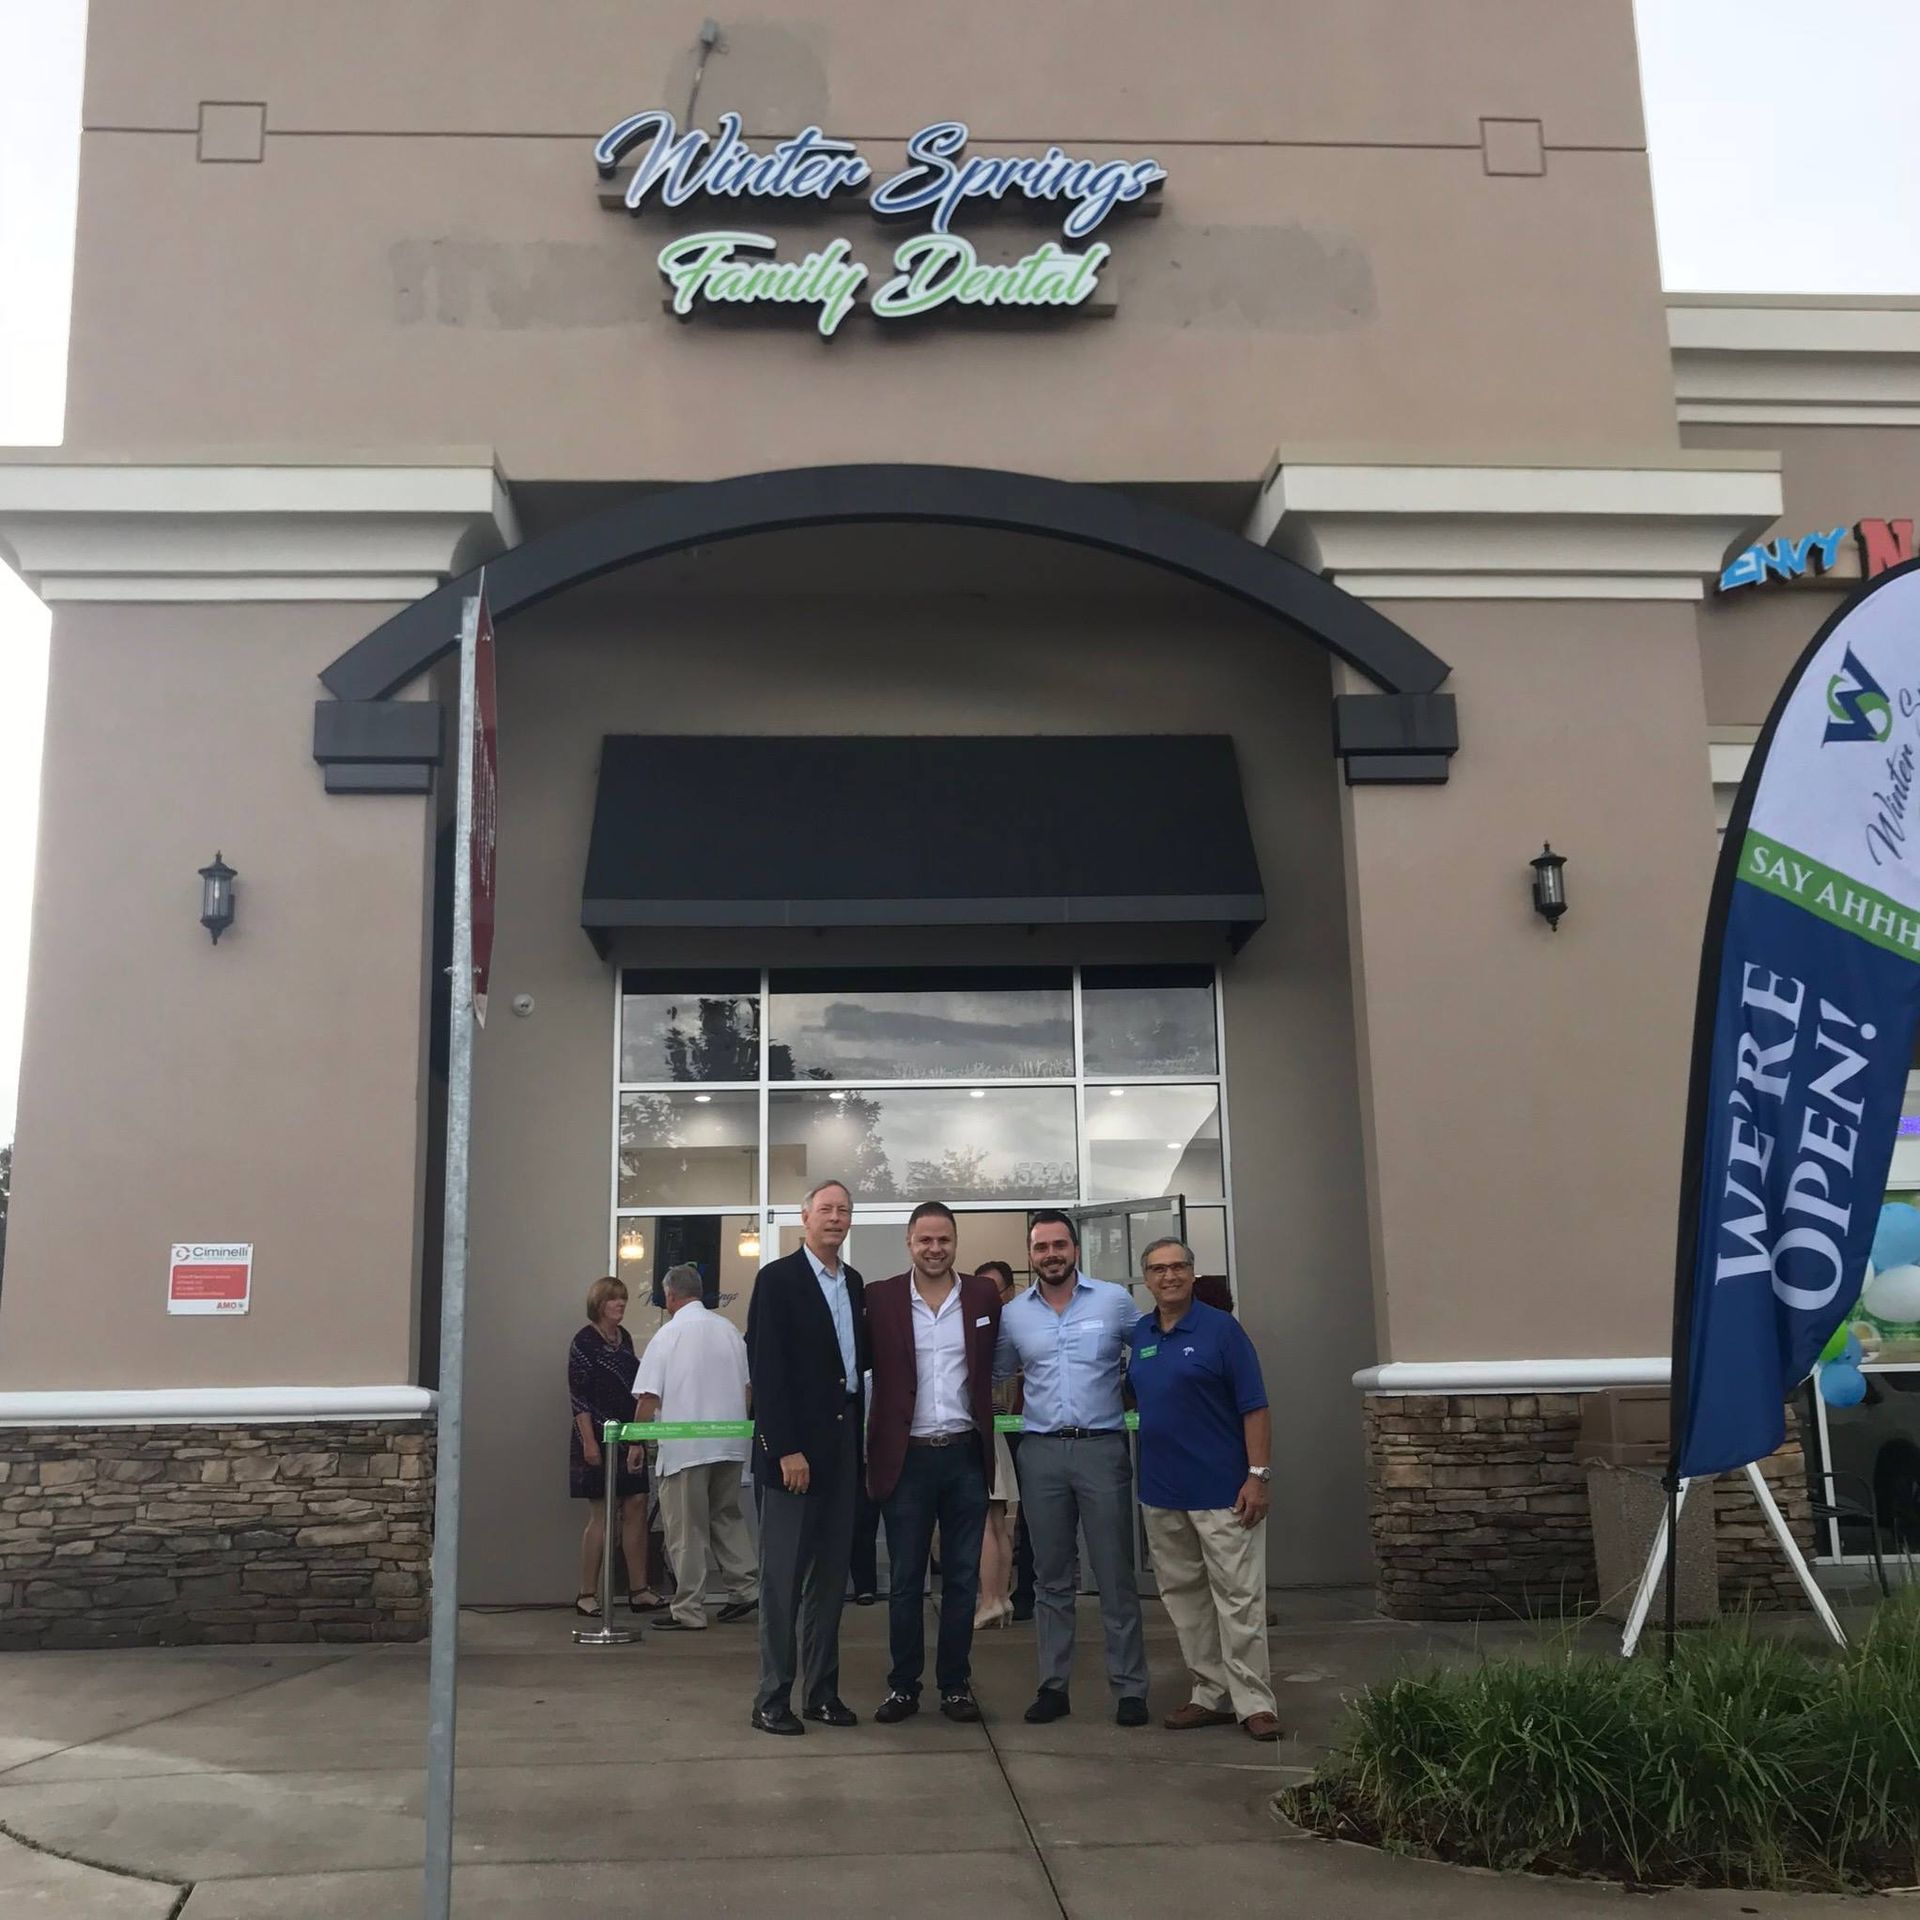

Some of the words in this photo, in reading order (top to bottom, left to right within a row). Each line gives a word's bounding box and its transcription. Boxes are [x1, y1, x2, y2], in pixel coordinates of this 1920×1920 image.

[594, 110, 872, 208] Winter
[870, 121, 1168, 238] Springs
[657, 231, 869, 336] Family
[871, 234, 1114, 317] Dental
[1719, 526, 1848, 592] ENVY
[1865, 744, 1915, 867] Winter
[1750, 846, 1814, 895] SAY
[1715, 960, 1806, 1286] WE'RE
[1770, 997, 1878, 1311] OPEN!
[192, 1246, 248, 1257] Ciminelli
[216, 1301, 237, 1310] AMO
